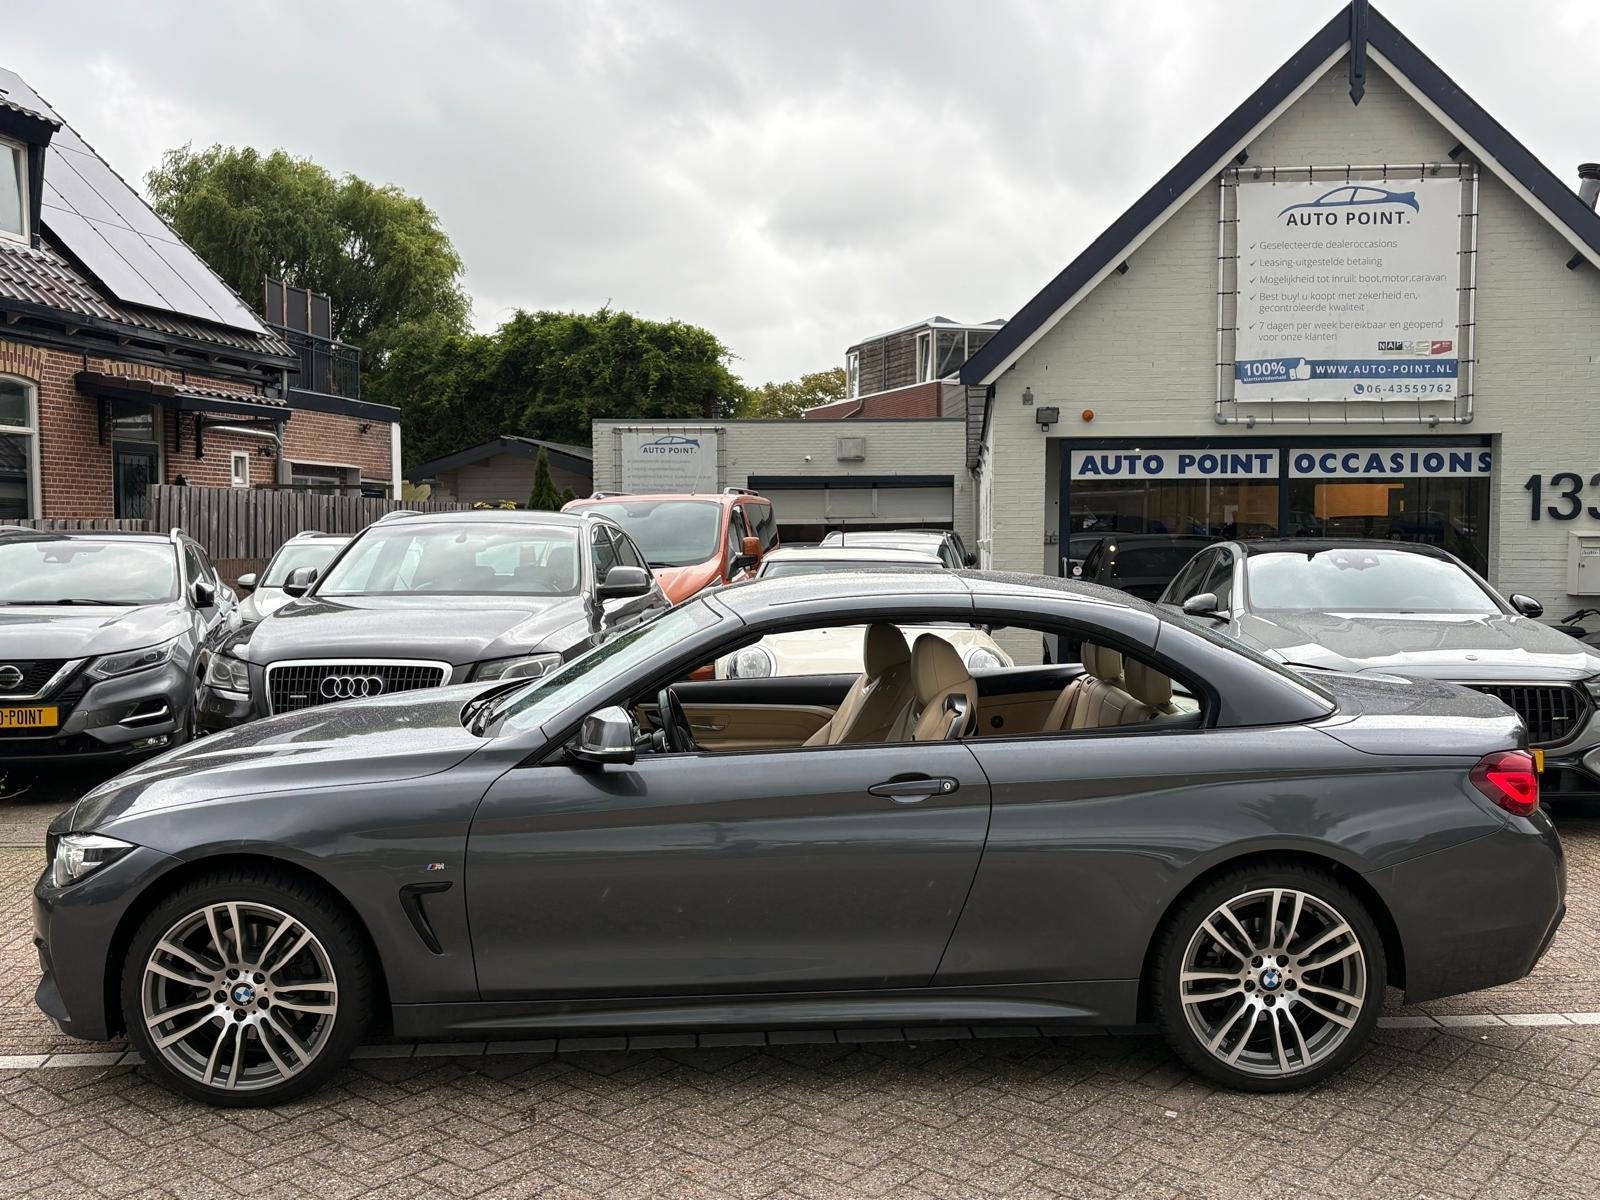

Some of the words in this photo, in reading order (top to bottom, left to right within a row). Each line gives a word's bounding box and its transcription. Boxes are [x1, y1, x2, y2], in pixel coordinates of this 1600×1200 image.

[1286, 212, 1338, 226] AUTO
[1346, 211, 1411, 225] POINT.
[1259, 241, 1323, 250] Geselecteerde
[1325, 239, 1398, 249] dealeroccasions
[1346, 257, 1383, 268] betaling
[1259, 275, 1315, 286] Mogelijkheid
[1316, 275, 1329, 283] tot
[1259, 292, 1279, 301] Best
[1310, 292, 1336, 302] koopt
[1338, 292, 1356, 300] met
[1358, 291, 1402, 300] zekerheid
[1259, 303, 1327, 314] gecontroleerde
[1328, 303, 1365, 311] kwaliteit
[1259, 321, 1265, 330] 7
[1266, 321, 1295, 332] dagen
[1296, 322, 1312, 332] per
[1314, 320, 1338, 329] week
[1339, 320, 1387, 329] bereikbaar
[1402, 319, 1443, 331] geopend
[1304, 331, 1338, 341] klanten
[1244, 361, 1286, 376] 100%
[1315, 364, 1453, 374] WWW.AUTO-POINT.NL
[1366, 384, 1452, 393] 06-43559762
[1078, 455, 1164, 475] AUTO
[1178, 453, 1273, 474] POINT
[1294, 452, 1491, 474] OCCASIONS
